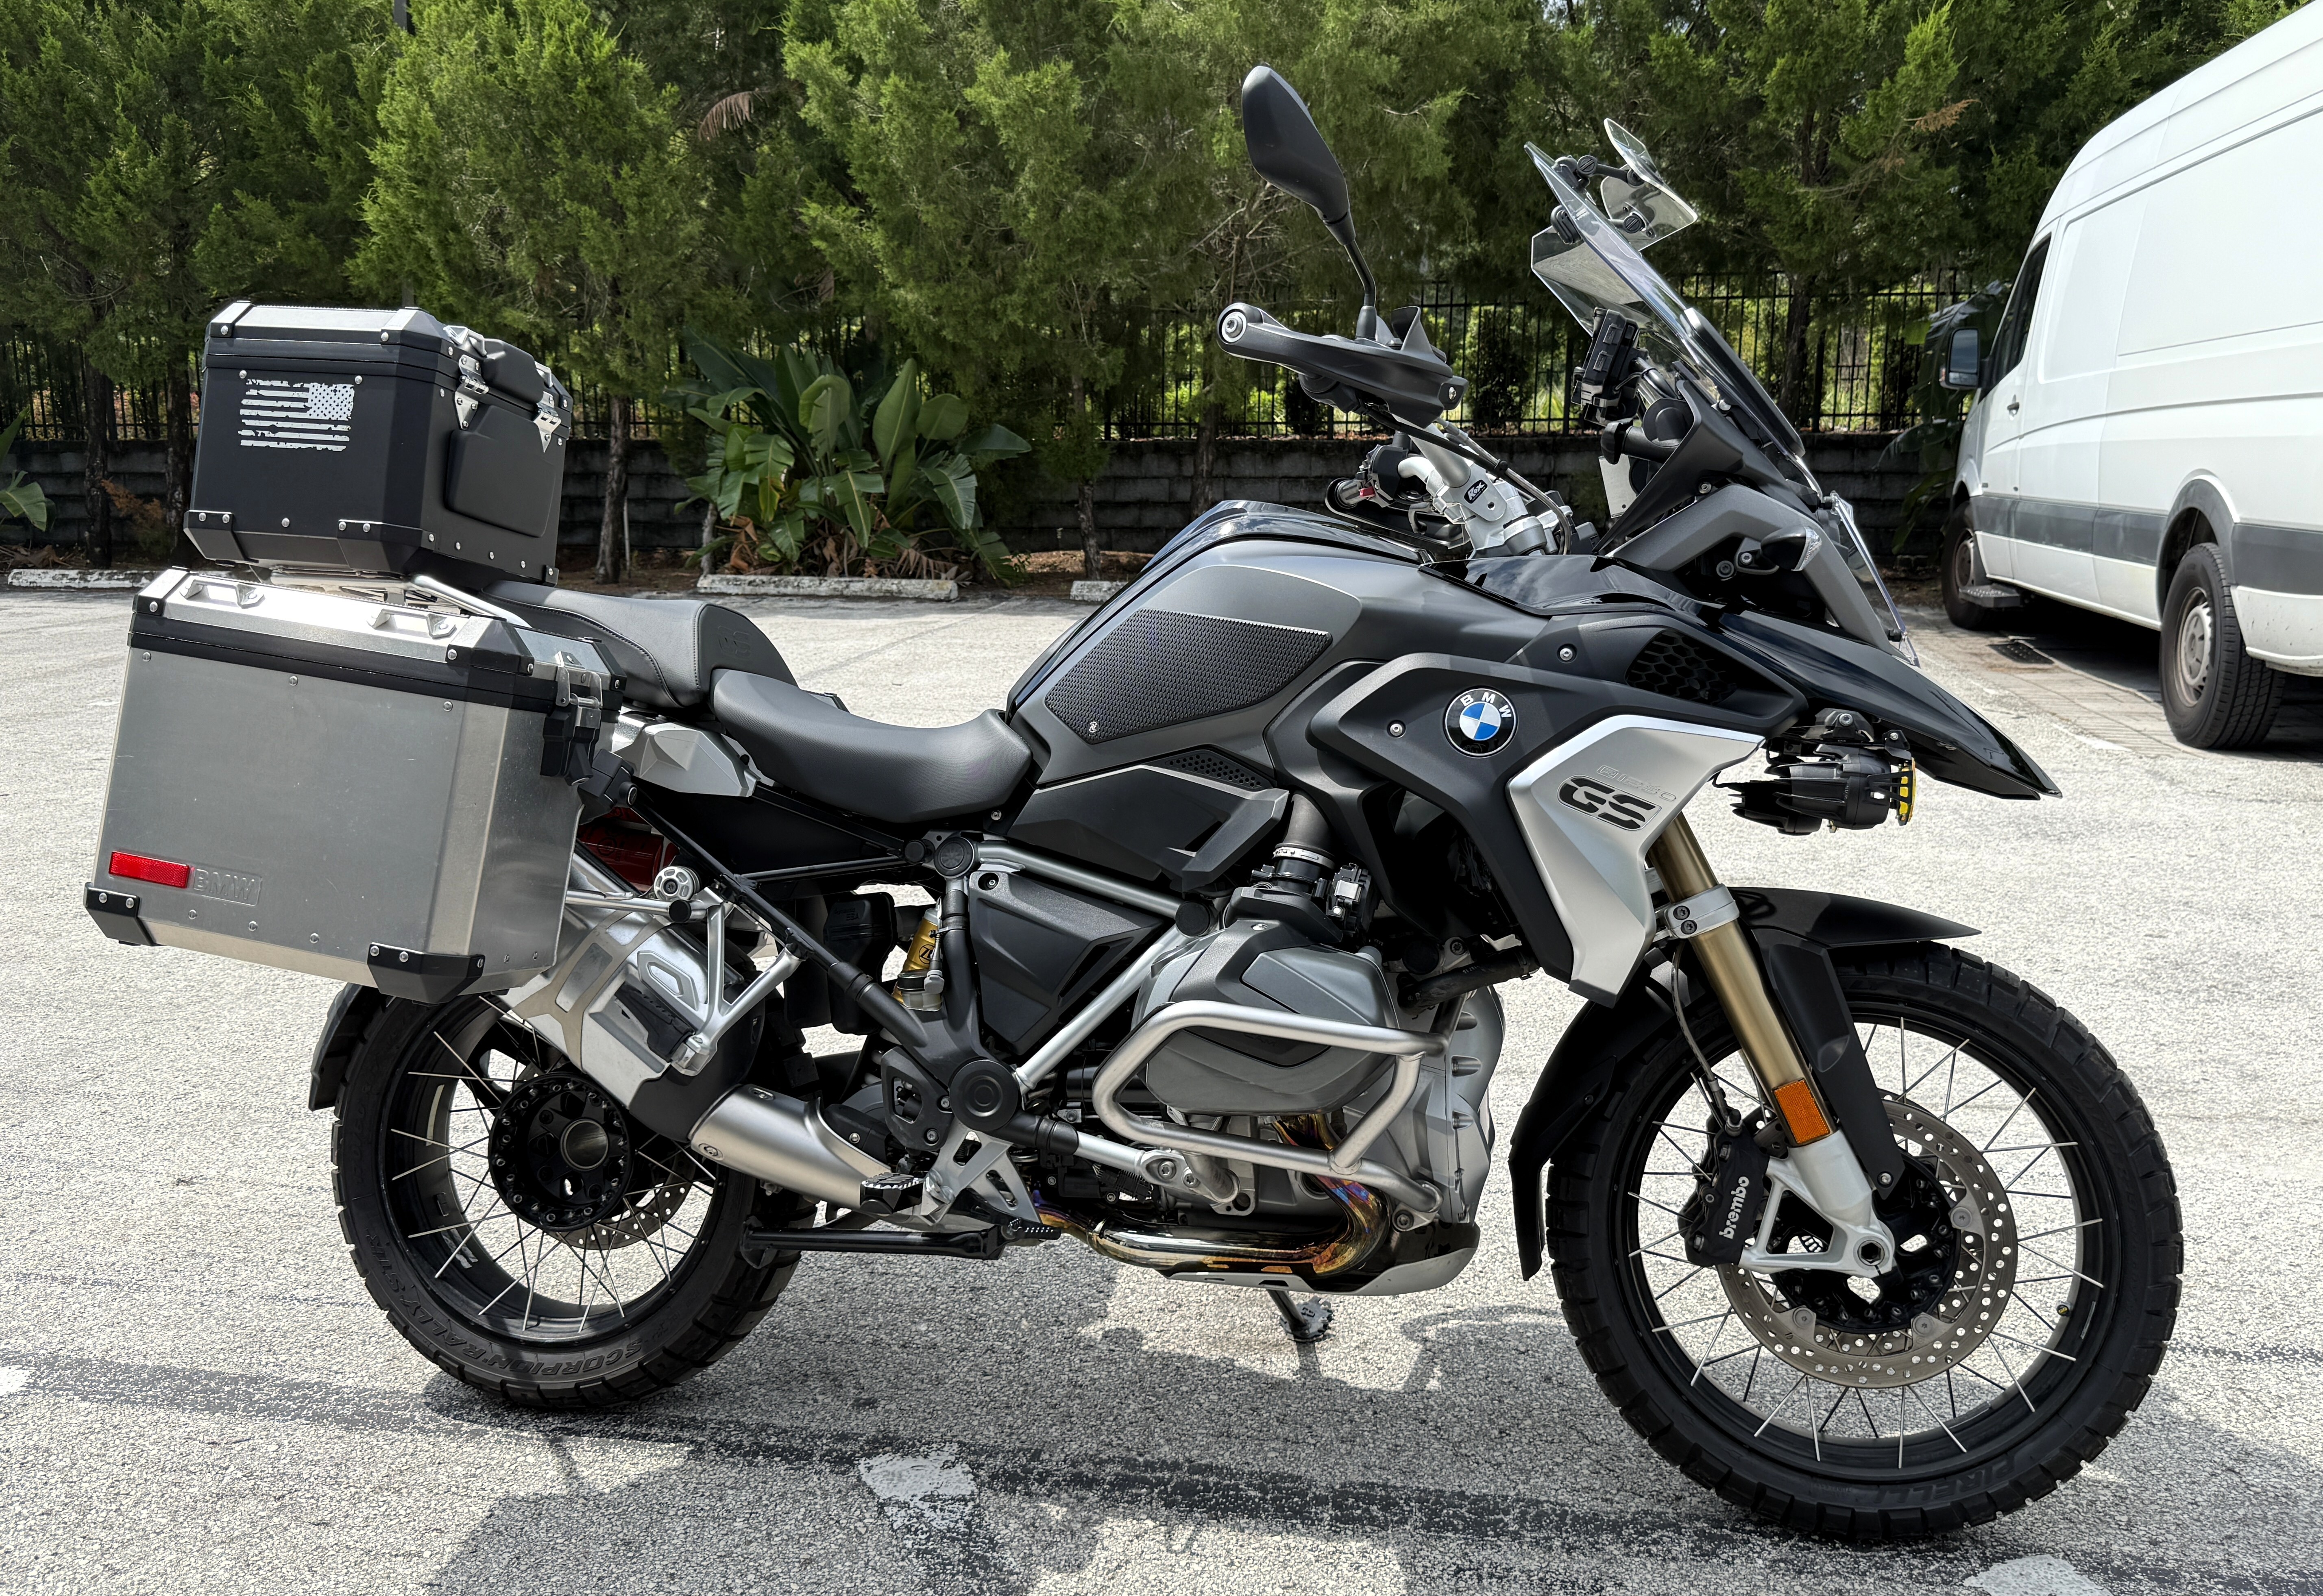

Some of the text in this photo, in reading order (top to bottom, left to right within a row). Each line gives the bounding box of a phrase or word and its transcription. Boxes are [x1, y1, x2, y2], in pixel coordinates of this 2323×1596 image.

[1460, 692, 1511, 718] BMW
[1559, 777, 1656, 830] GS
[194, 869, 256, 899] BMW
[1719, 1176, 1749, 1239] brembo
[400, 1298, 487, 1359] RALLY
[487, 1339, 642, 1376] SCORPION
[1873, 1454, 2016, 1504] PIRELLI
